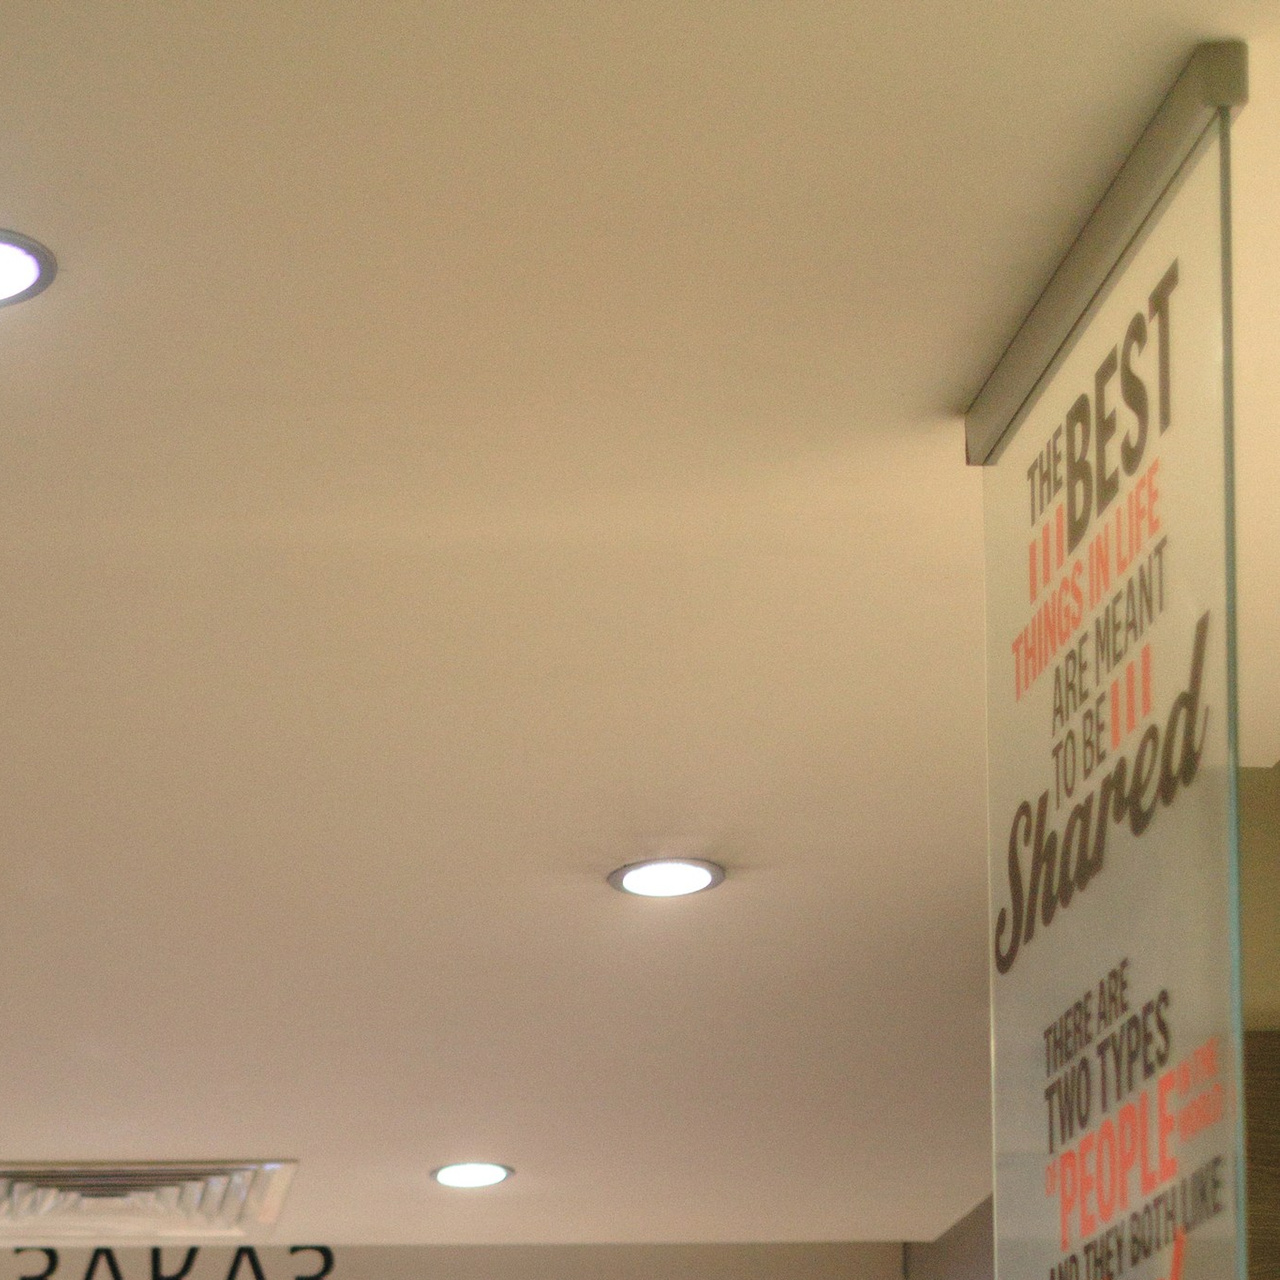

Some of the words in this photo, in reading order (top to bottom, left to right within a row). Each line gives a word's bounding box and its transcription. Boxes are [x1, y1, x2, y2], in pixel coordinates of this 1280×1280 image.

[1027, 424, 1063, 527] THE
[1066, 256, 1180, 557] BEST
[1011, 559, 1084, 703] THINGS
[1089, 522, 1111, 612] IN
[1116, 457, 1161, 577] LIFE
[1052, 631, 1089, 738] ARE
[1095, 535, 1168, 687] MEANT
[995, 608, 1211, 975] Shared
[1052, 729, 1077, 811] TO
[1082, 692, 1107, 780] BE
[1043, 989, 1092, 1079] THERE
[1097, 957, 1129, 1034] ARE
[1044, 1056, 1091, 1154] TWO
[1097, 988, 1170, 1113] TYPES
[1059, 1069, 1178, 1253] PEOPLE
[1130, 1185, 1176, 1268] BOTH
